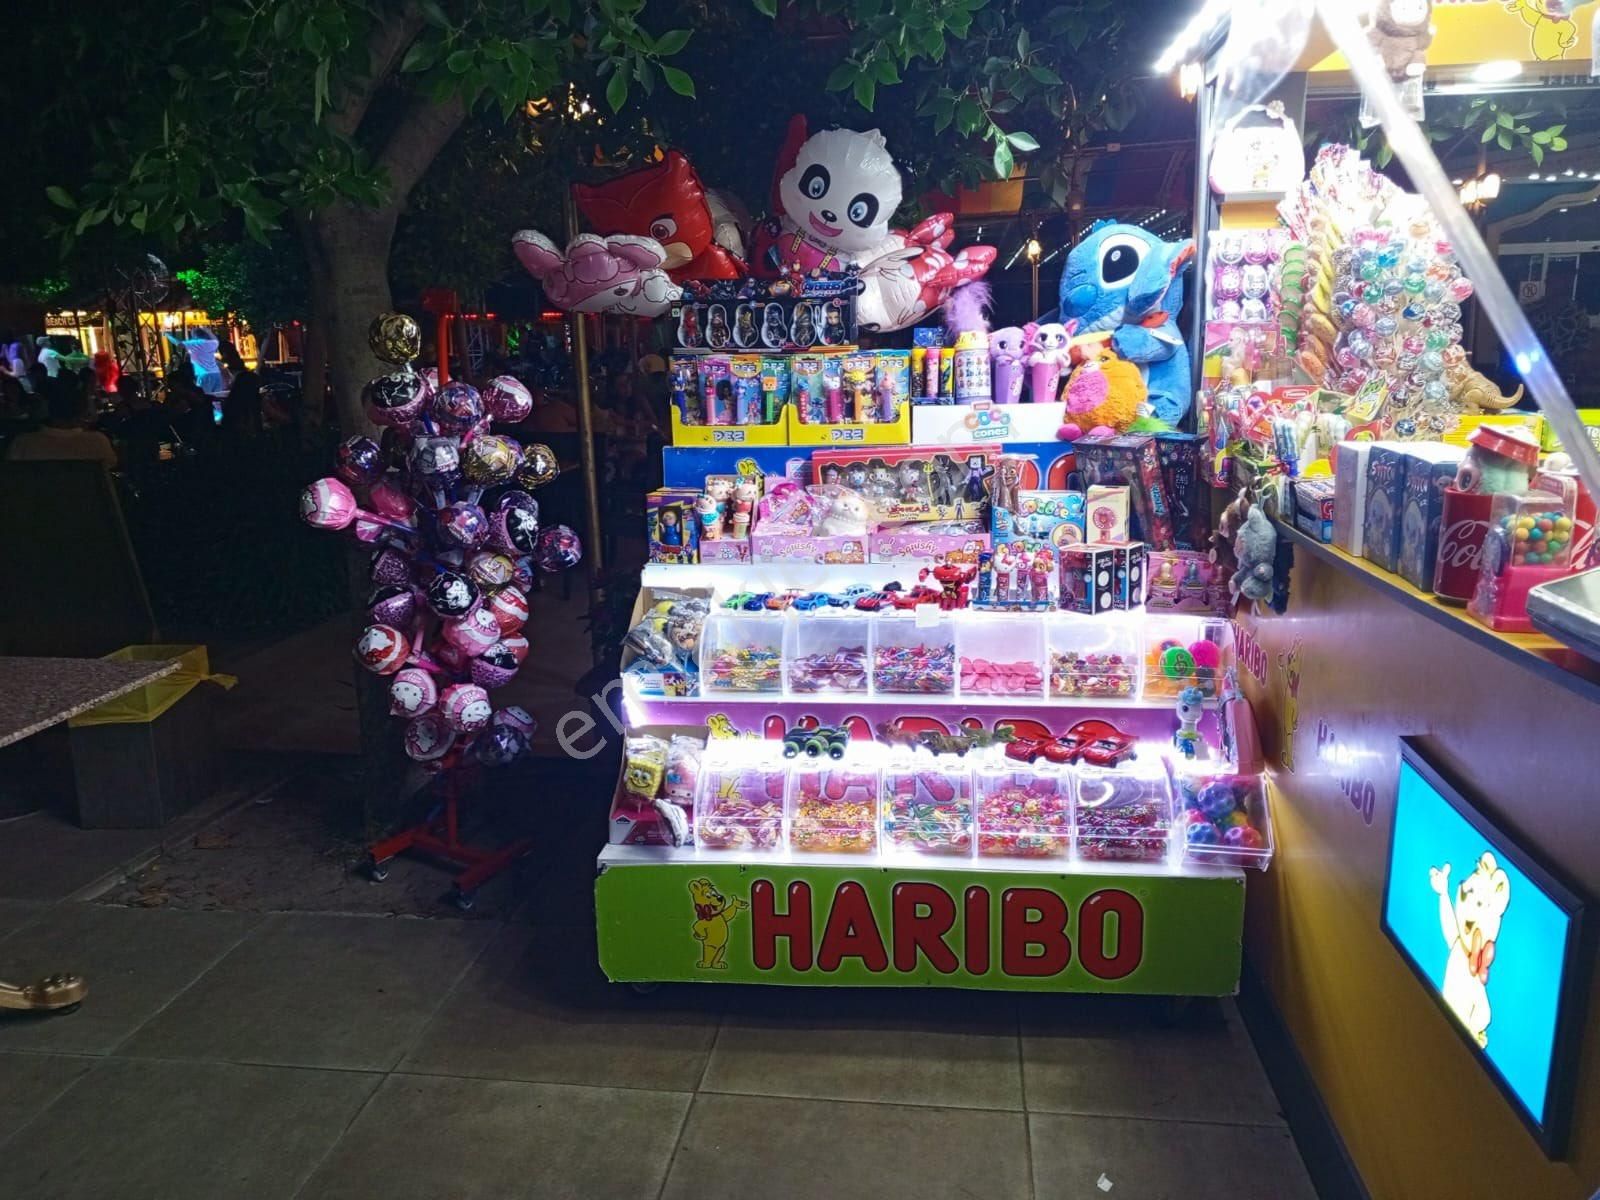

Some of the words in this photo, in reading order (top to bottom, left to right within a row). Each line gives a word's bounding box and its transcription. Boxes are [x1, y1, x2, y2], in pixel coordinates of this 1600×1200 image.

[713, 430, 745, 442] PEZ
[831, 429, 864, 441] PEZ
[779, 541, 817, 559] Squishy
[898, 541, 937, 559] Squishy
[1232, 622, 1268, 687] HARIBO
[751, 879, 1144, 980] HARIBO
